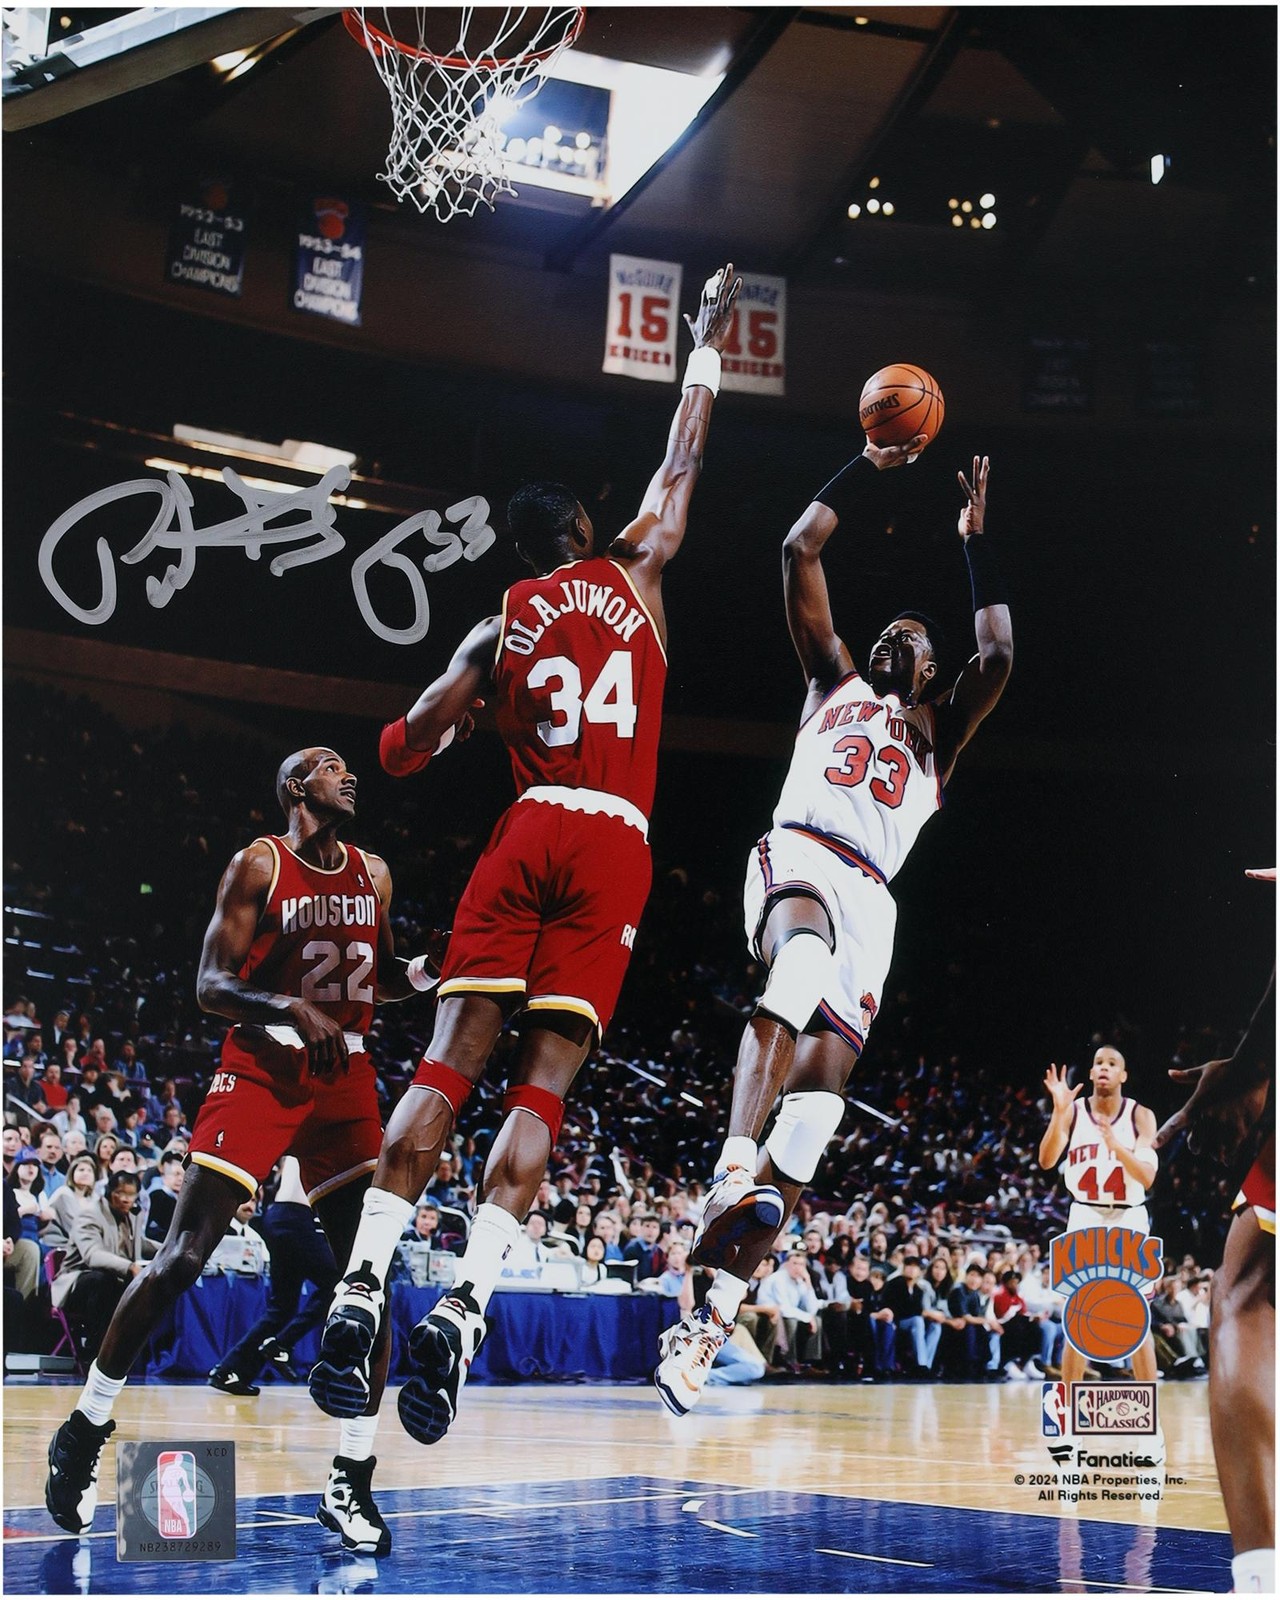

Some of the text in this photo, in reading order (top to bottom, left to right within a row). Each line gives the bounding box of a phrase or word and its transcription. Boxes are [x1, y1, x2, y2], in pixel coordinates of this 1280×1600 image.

[617, 292, 670, 343] 15
[726, 308, 778, 358] 15
[505, 579, 646, 655] OLAJUWON
[527, 650, 637, 747] 34
[817, 700, 884, 734] NEW
[824, 735, 911, 809] 33
[301, 940, 374, 1004] 22
[1069, 1143, 1099, 1167] NEW
[1078, 1166, 1126, 1201] 44
[206, 1447, 228, 1457] XCD
[140, 1541, 222, 1553] NB238729289
[164, 1520, 183, 1533] NBA
